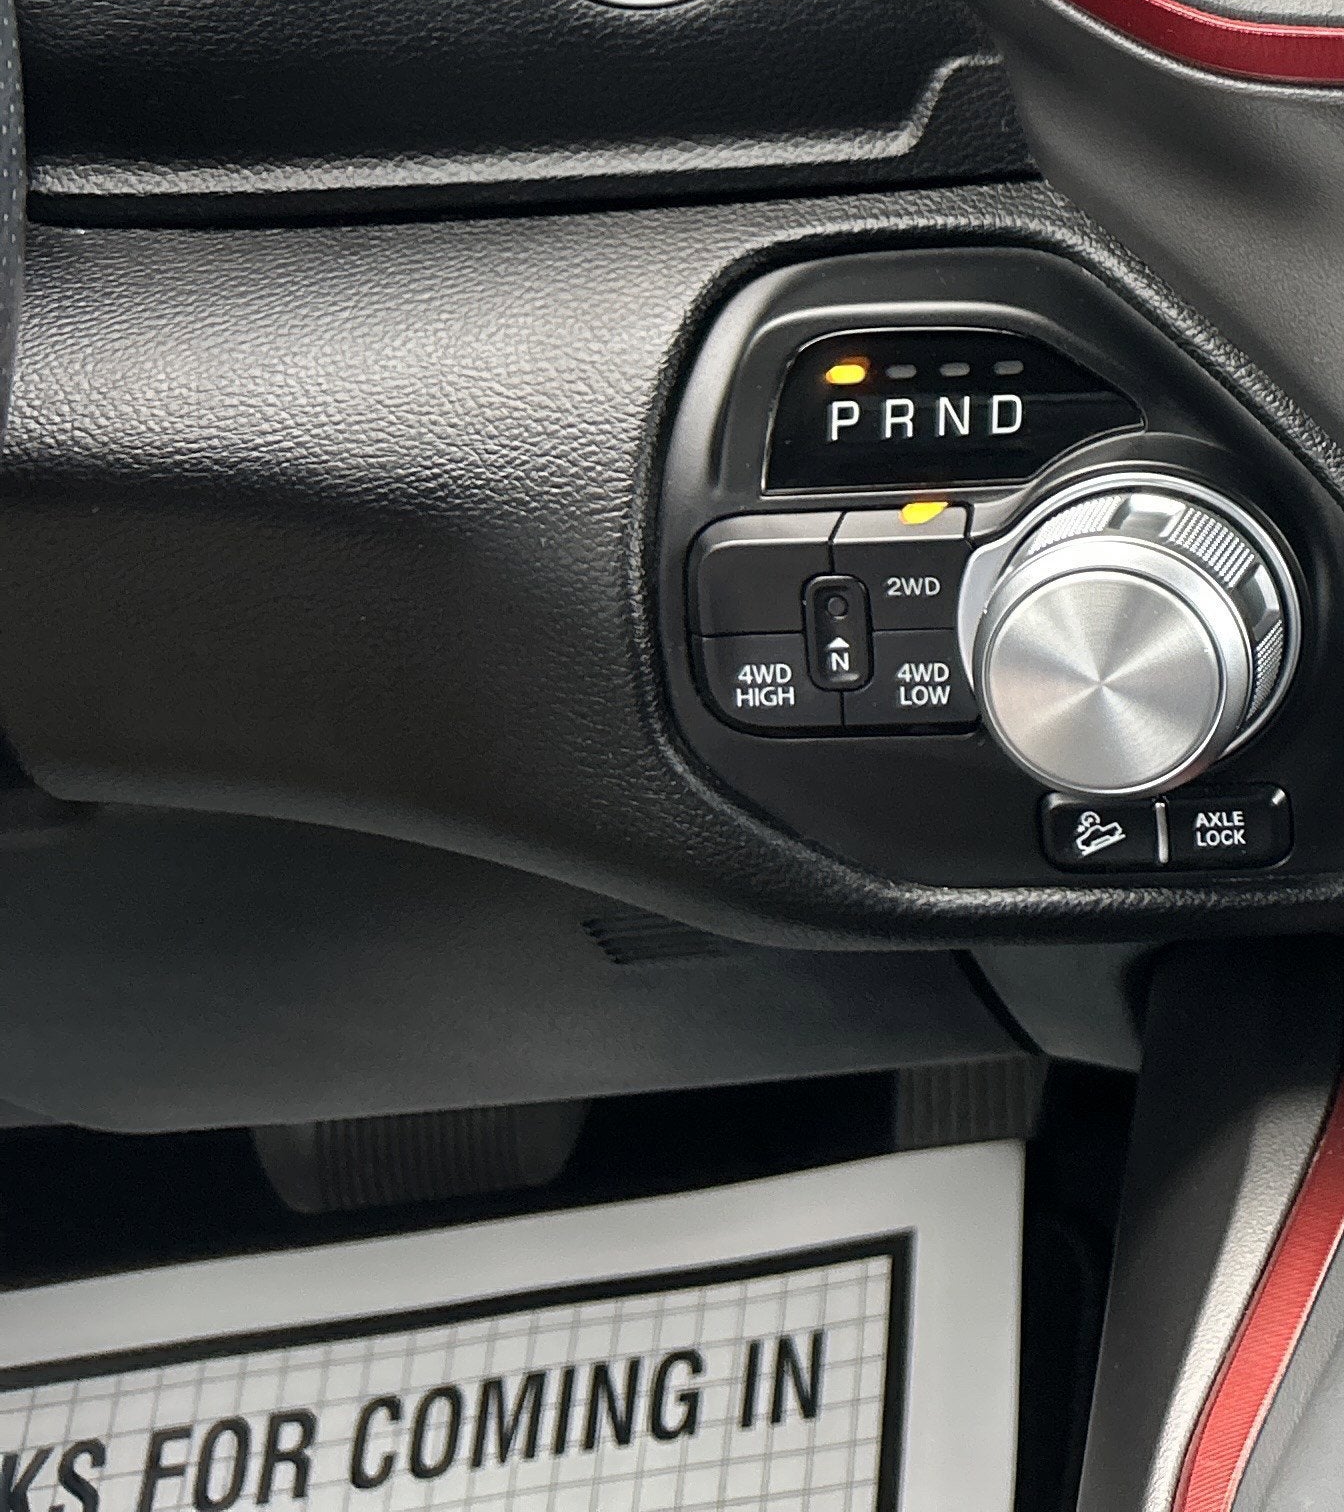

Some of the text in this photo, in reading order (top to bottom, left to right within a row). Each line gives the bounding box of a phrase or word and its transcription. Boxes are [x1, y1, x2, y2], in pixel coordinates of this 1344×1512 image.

[830, 394, 1023, 441] P R N D
[886, 575, 941, 598] 2WD
[830, 650, 850, 672] N
[737, 663, 793, 686] 4WD
[897, 662, 950, 685] 4WD
[735, 686, 795, 708] HIGH
[899, 685, 951, 707] LOW
[1195, 810, 1245, 829] AXLE
[1196, 828, 1246, 847] LOCK
[136, 1408, 319, 1512] FOR
[349, 1347, 708, 1490] COMING
[739, 1329, 827, 1430] IN
